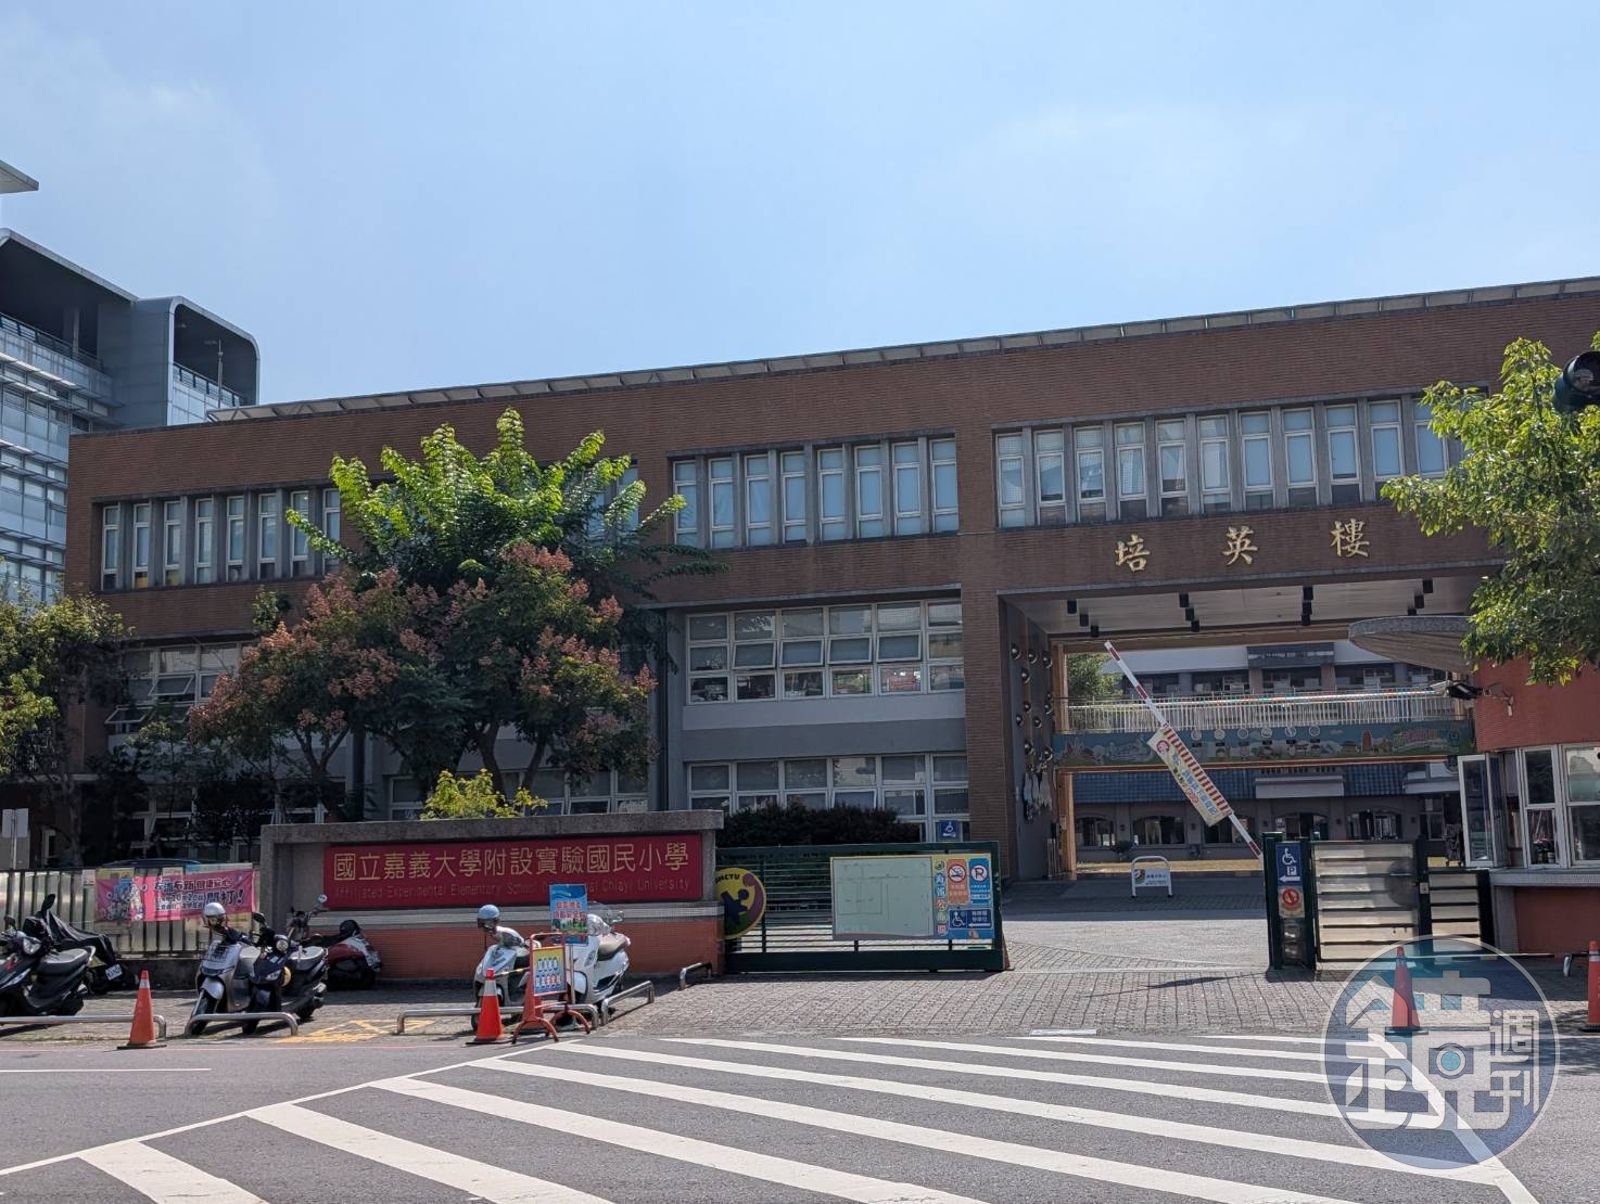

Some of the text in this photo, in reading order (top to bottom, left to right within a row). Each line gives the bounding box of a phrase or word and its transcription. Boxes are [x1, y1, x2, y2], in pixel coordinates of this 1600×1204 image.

[1115, 518, 1370, 572] 培英樓
[333, 841, 689, 881] 國立嘉義大學附設實驗國民小學
[638, 877, 689, 891] University
